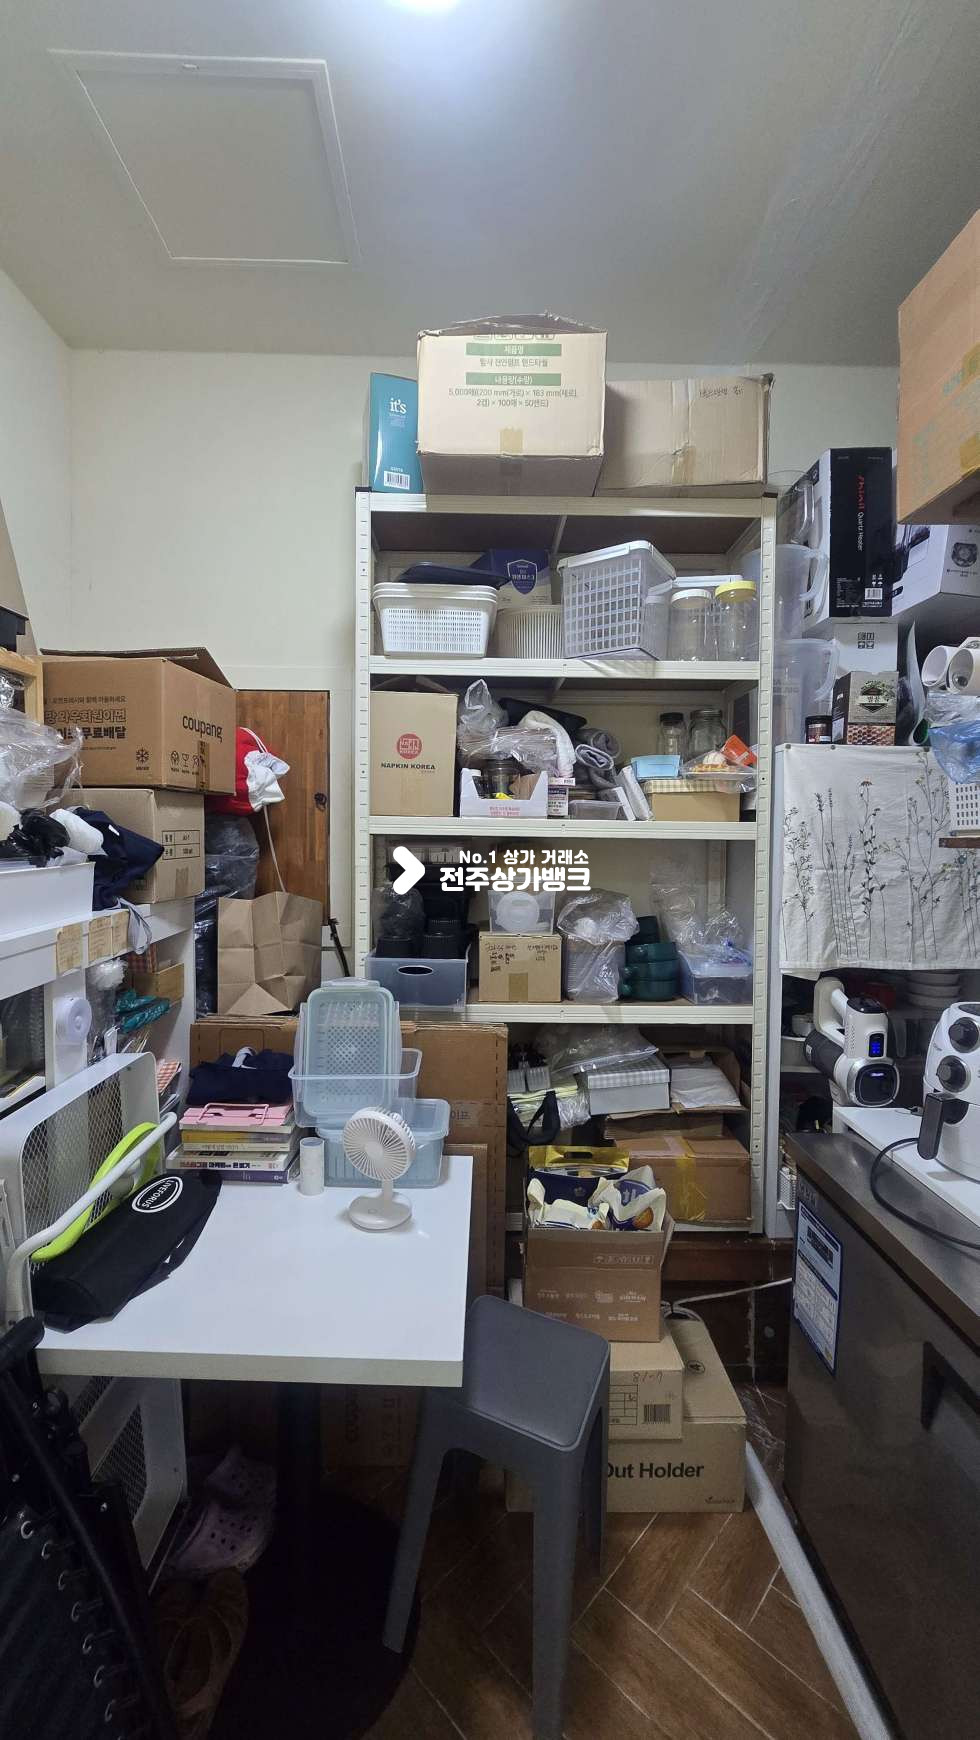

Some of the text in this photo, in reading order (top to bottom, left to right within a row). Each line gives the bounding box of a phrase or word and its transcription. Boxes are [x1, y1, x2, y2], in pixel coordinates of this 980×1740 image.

[182, 715, 223, 743] coupang
[141, 1179, 175, 1209] LIVEFORUS
[639, 1462, 705, 1479] Holder
